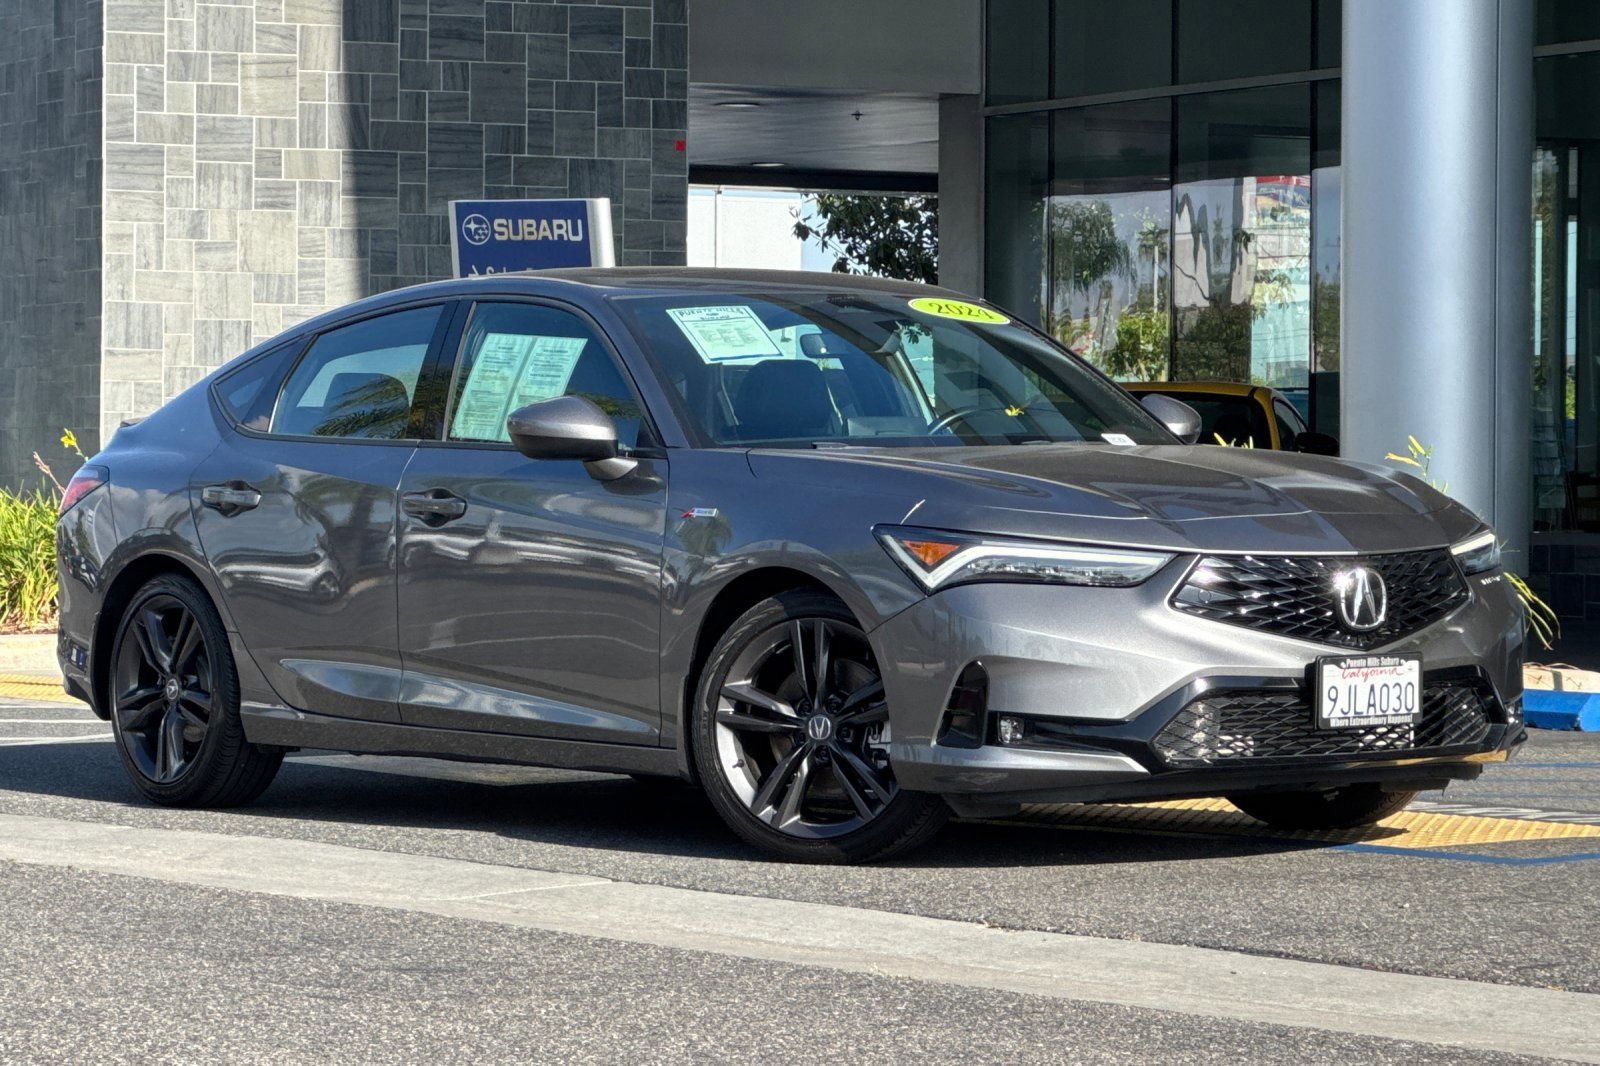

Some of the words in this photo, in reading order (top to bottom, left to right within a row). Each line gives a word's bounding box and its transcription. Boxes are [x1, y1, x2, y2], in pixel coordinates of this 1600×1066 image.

[493, 218, 583, 241] SUBARU
[1342, 667, 1404, 683] California
[1327, 682, 1415, 717] 9JLA030
